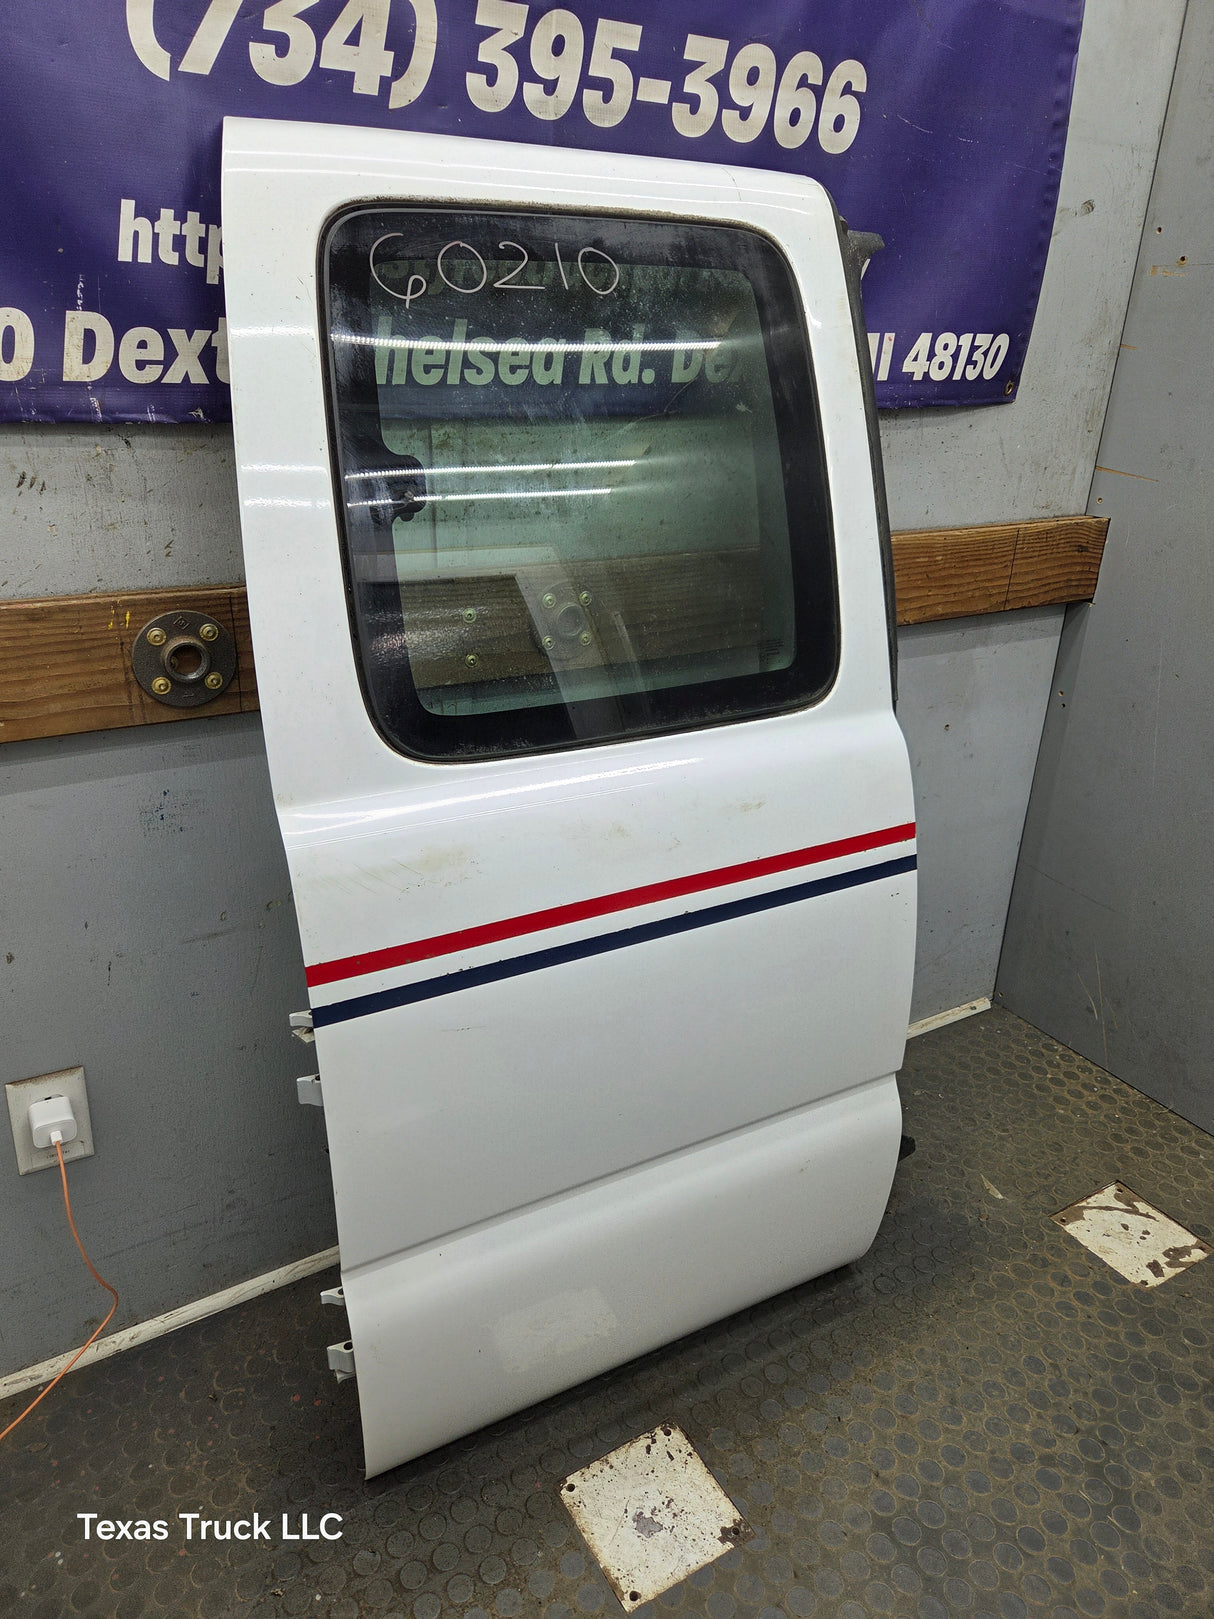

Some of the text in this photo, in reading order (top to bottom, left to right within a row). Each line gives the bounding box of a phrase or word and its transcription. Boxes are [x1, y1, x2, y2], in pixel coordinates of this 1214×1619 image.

[465, 0, 868, 154] 395-3966
[578, 322, 656, 385] Rd.
[902, 331, 1010, 381] 48130
